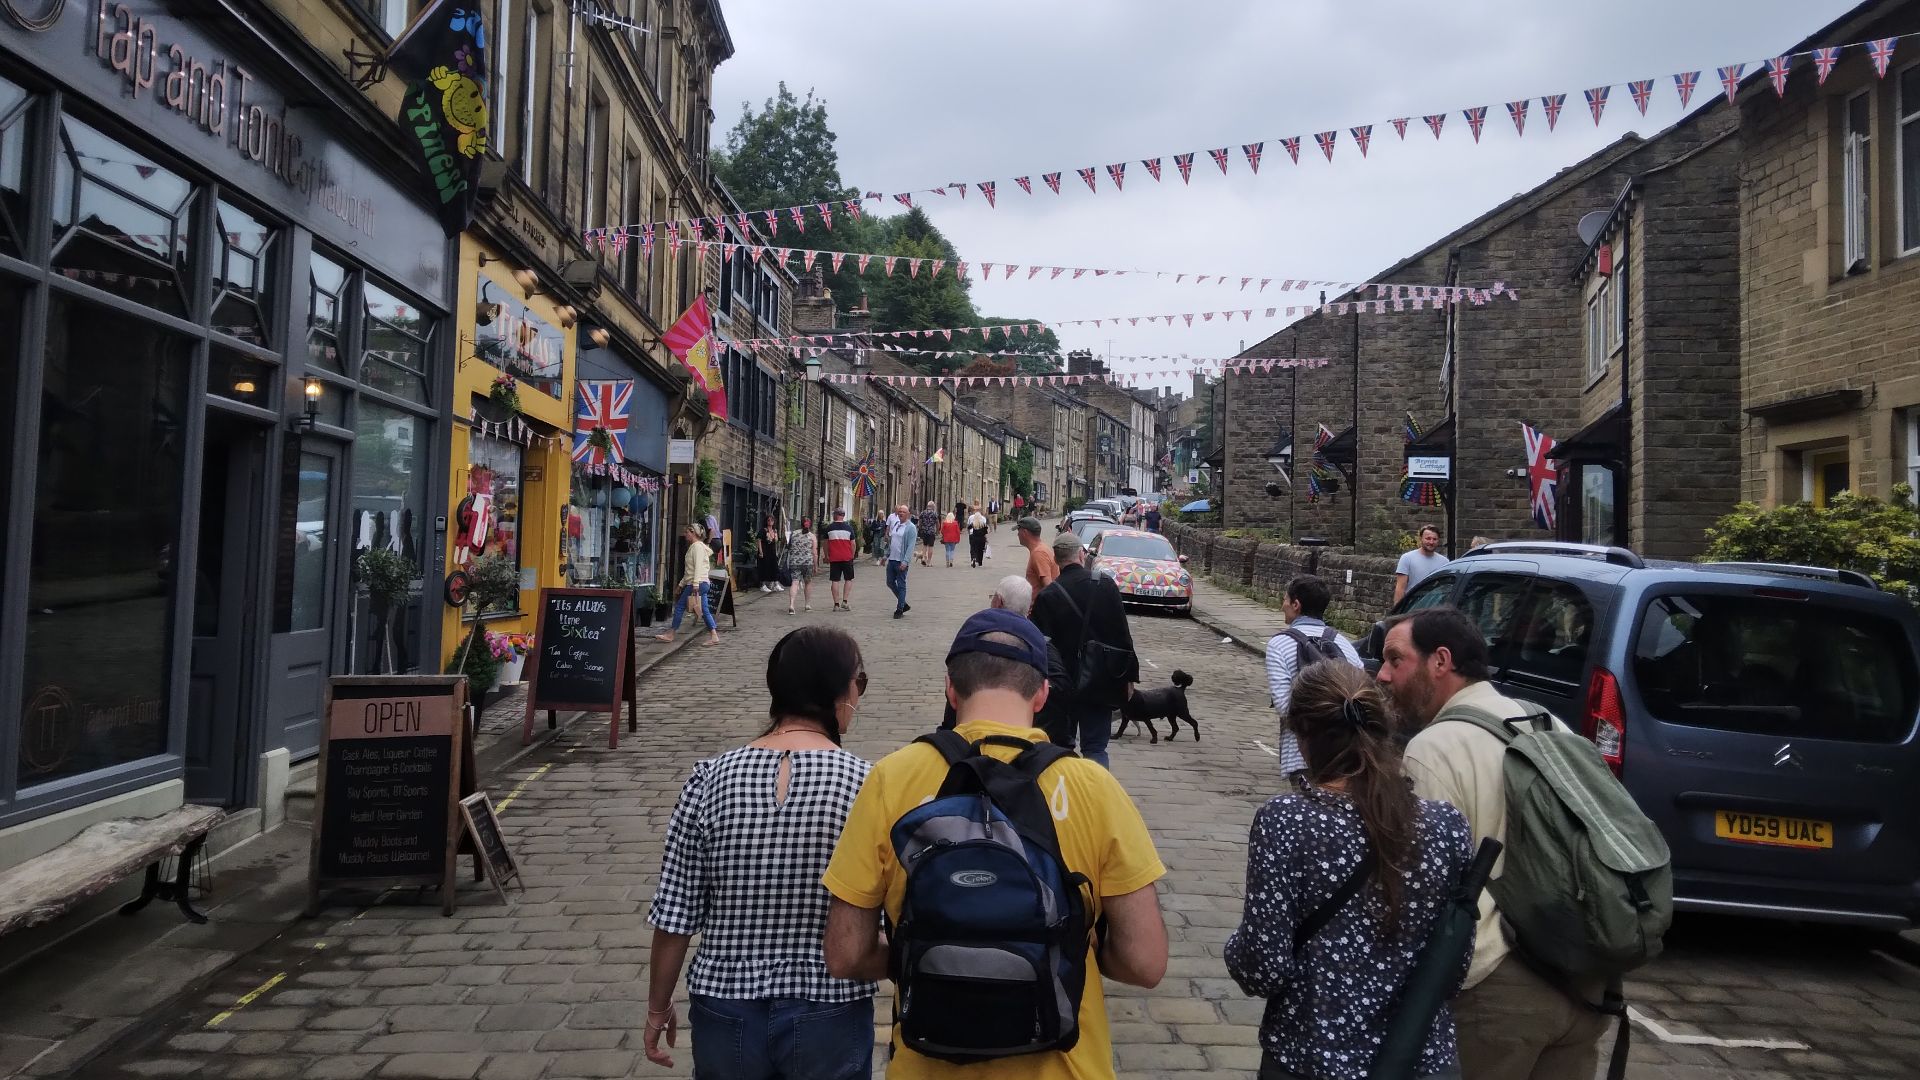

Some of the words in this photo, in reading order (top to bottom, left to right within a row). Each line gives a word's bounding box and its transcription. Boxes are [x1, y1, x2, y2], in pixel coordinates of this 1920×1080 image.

[166, 43, 227, 136] and
[232, 65, 302, 186] Tonic
[548, 644, 561, 656] Tea
[568, 645, 590, 660] Coffee
[584, 661, 604, 672] Scones
[364, 701, 421, 734] OPEN
[342, 749, 360, 761] Cask
[383, 747, 411, 761] Liqueur
[414, 746, 438, 759] Coffee
[345, 764, 390, 776] Champagne
[400, 762, 432, 775] Cocktails
[347, 786, 361, 799] Sky
[393, 784, 402, 797] BT
[403, 784, 429, 797] Sports
[377, 809, 394, 822] Beer
[396, 809, 423, 821] Garden
[1724, 813, 1780, 838] YD59
[1786, 821, 1825, 843] UAC
[353, 836, 378, 849] Muddy
[381, 835, 401, 847] Boots
[403, 834, 418, 847] and
[338, 852, 364, 864] Muddy
[367, 850, 389, 863] Paws
